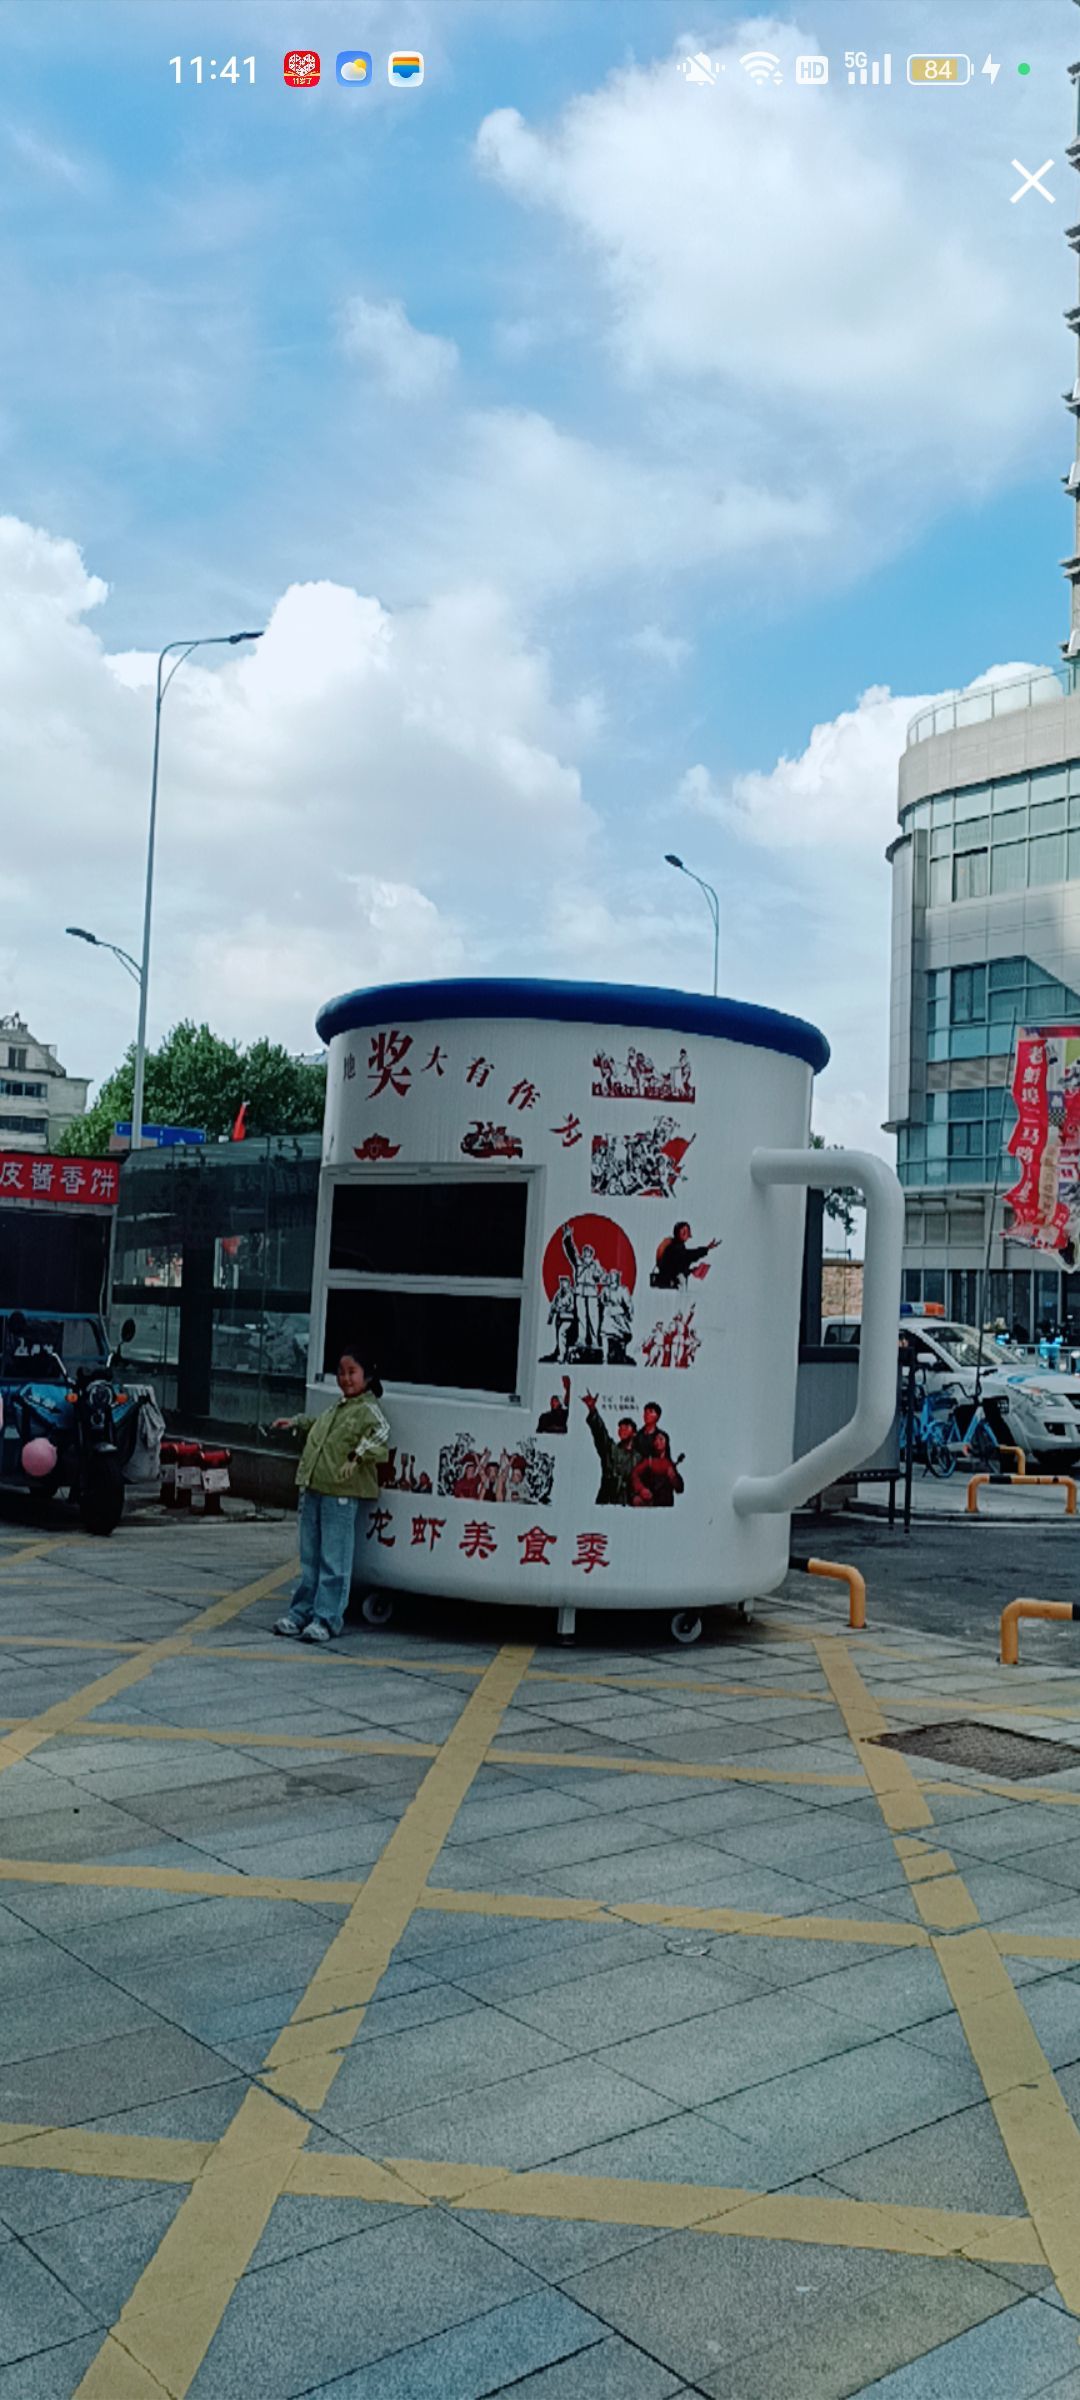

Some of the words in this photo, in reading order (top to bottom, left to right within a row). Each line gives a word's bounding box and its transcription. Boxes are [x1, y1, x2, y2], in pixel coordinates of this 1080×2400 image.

[366, 1508, 610, 1574] 龙虾美食季
